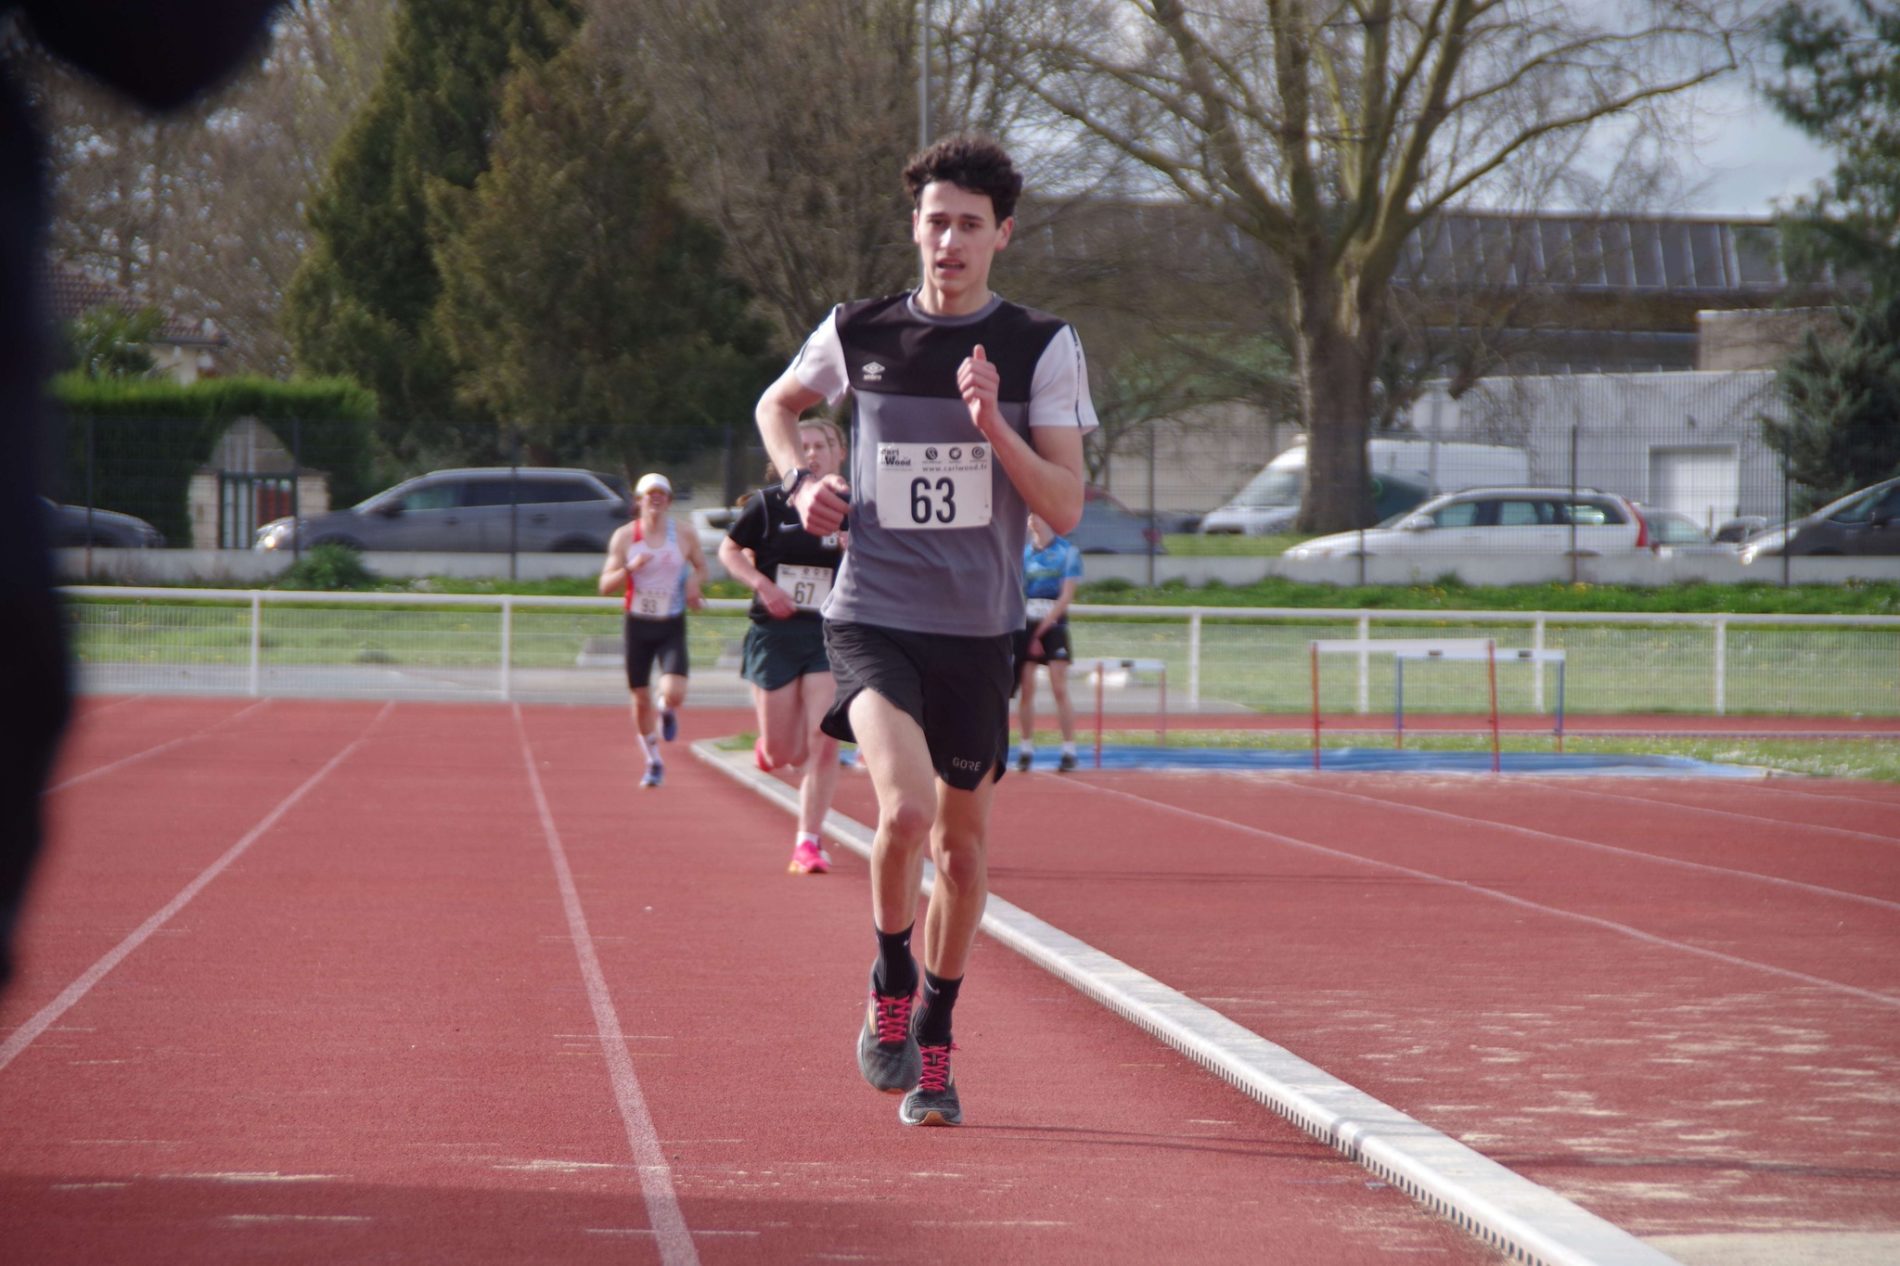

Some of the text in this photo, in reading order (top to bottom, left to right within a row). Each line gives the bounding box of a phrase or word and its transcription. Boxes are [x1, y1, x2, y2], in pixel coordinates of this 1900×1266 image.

[911, 476, 956, 524] 63
[794, 582, 815, 605] 67
[952, 756, 982, 771] GORE
